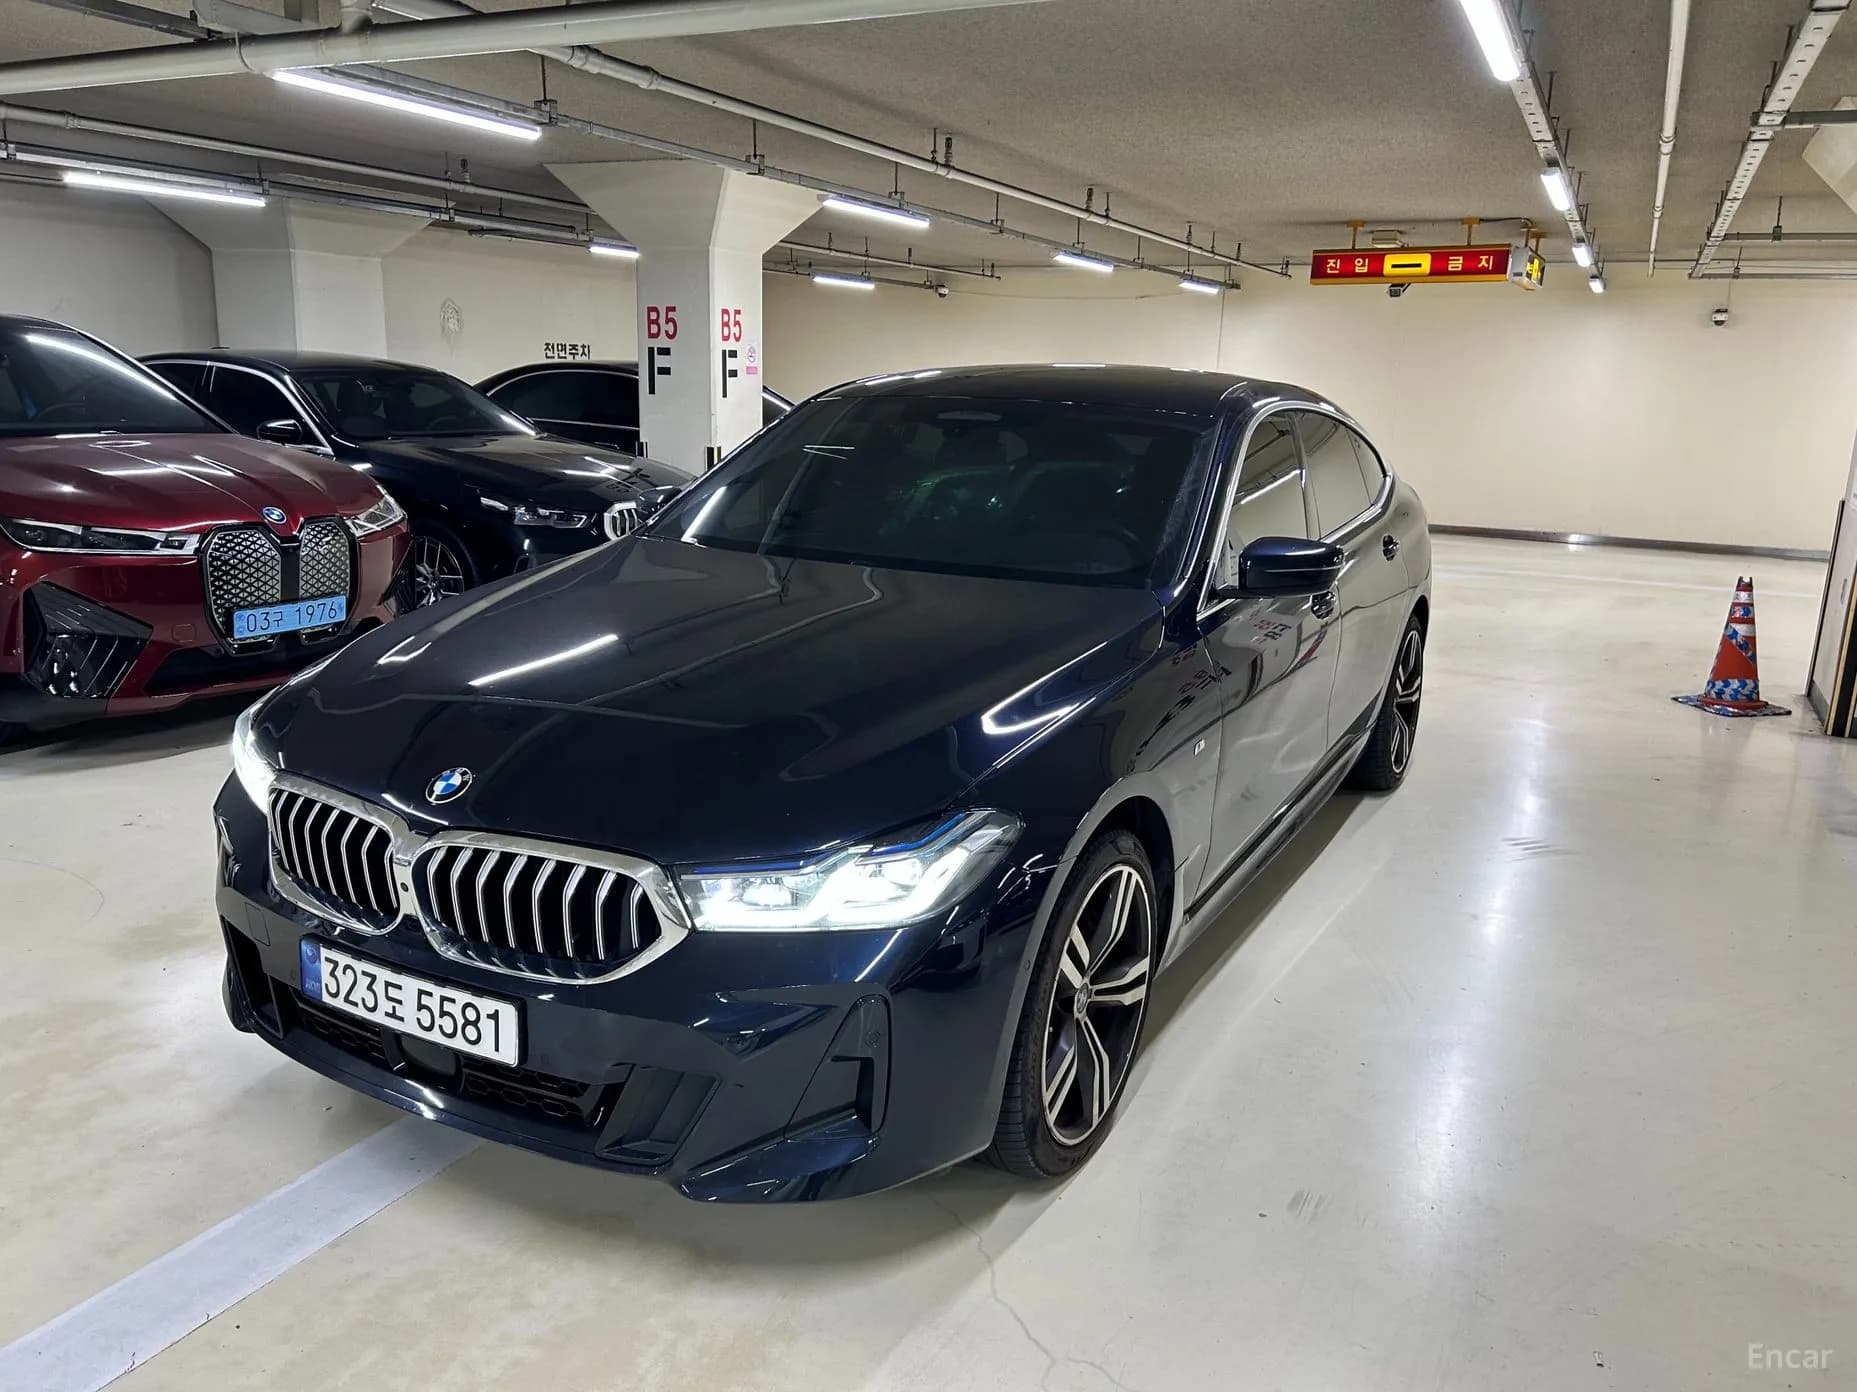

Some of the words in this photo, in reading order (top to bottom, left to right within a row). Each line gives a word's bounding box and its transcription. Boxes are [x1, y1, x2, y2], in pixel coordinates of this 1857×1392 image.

[646, 305, 678, 340] B5
[721, 308, 742, 342] B5
[543, 342, 590, 360] 전면주차
[647, 346, 671, 395] F
[721, 349, 738, 398] F
[246, 610, 284, 633] 03구
[295, 601, 338, 625] 1976
[324, 956, 405, 1022] 323도
[415, 988, 500, 1053] 5581
